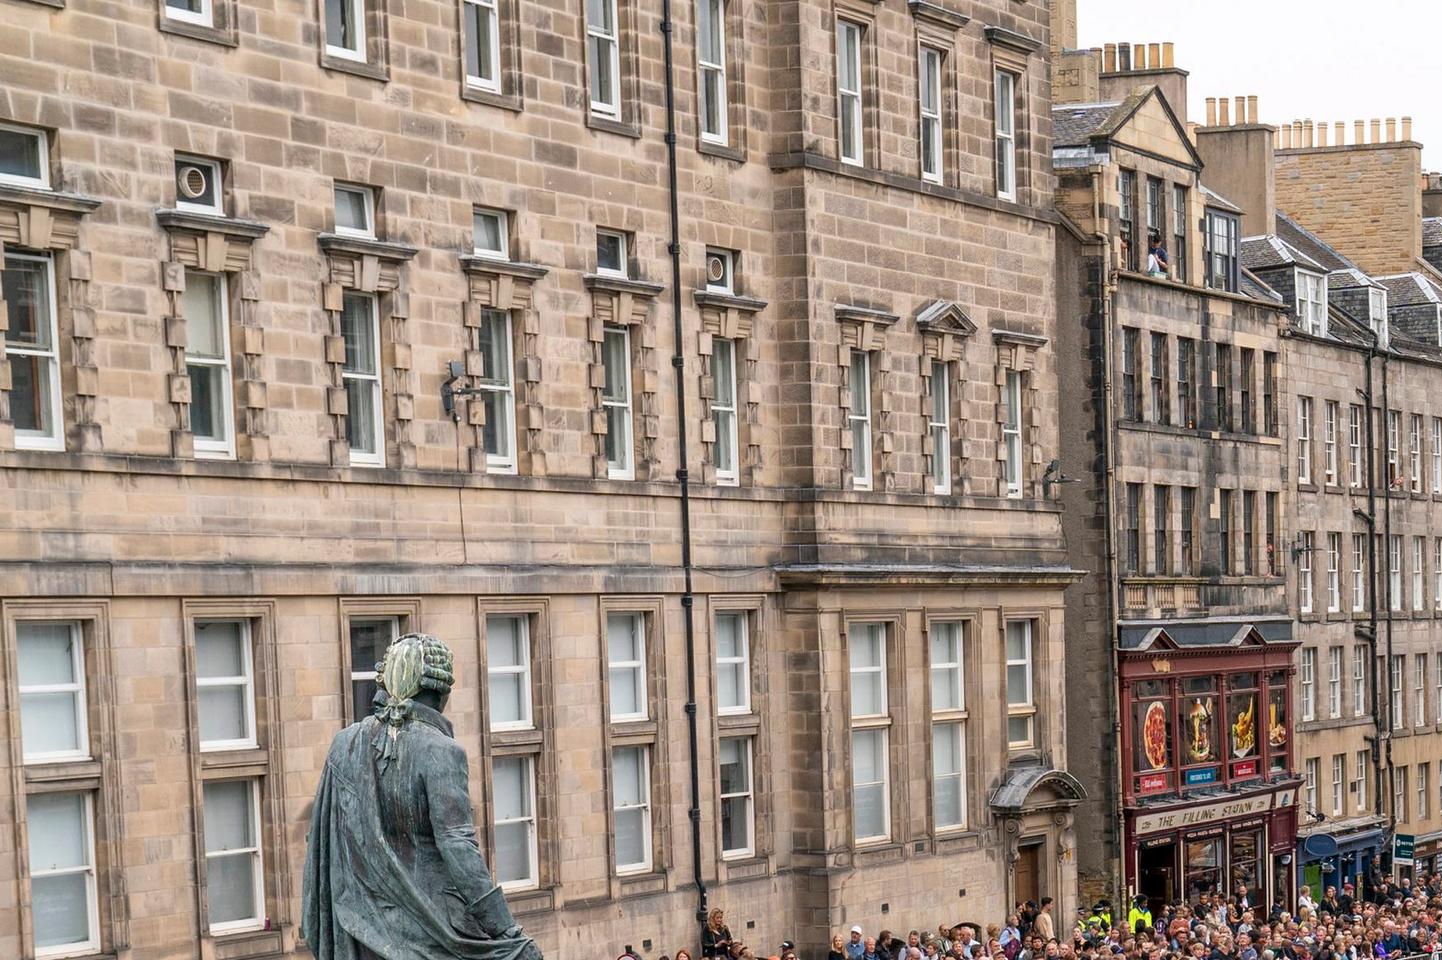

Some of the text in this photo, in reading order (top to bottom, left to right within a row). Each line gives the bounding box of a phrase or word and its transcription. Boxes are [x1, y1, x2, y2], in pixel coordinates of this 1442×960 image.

[1158, 815, 1175, 828] THE
[1183, 808, 1215, 824] FILLING
[1221, 801, 1253, 817] STATION
